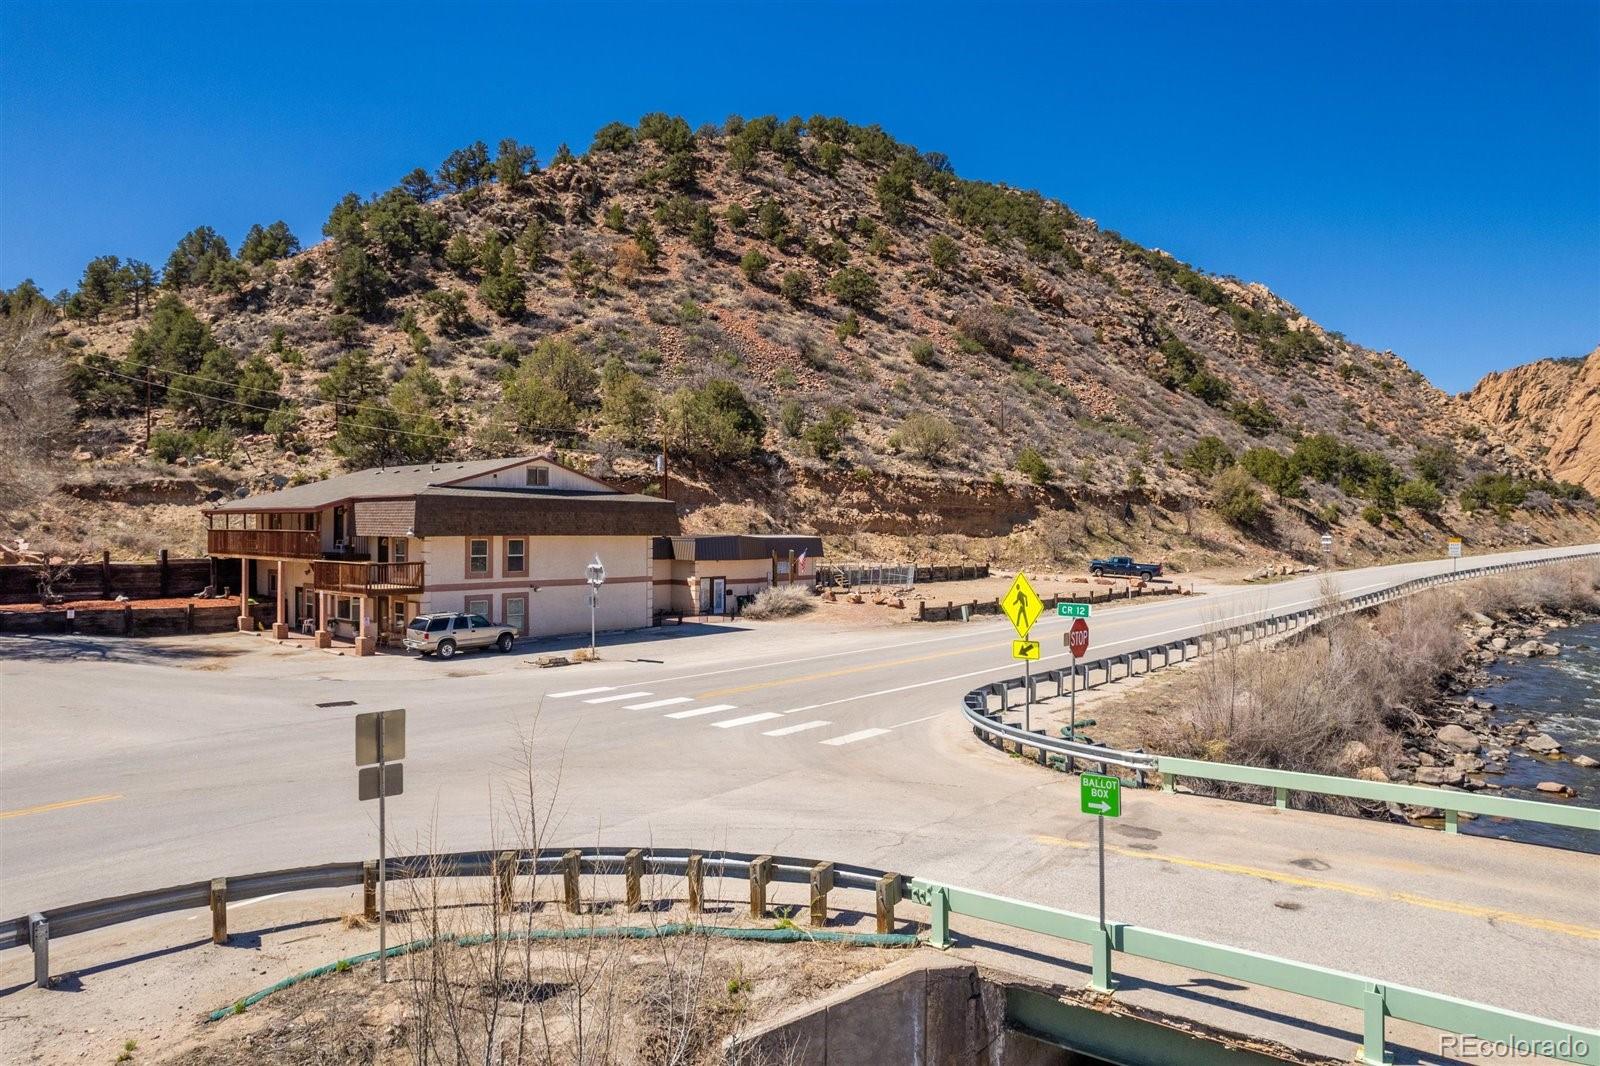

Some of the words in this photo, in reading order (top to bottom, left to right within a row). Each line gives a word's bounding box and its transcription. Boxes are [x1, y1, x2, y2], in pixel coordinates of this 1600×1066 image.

[1062, 606, 1072, 614] CR
[1076, 606, 1086, 616] 12
[1070, 630, 1088, 646] STOP
[1082, 778, 1117, 790] BALLOT
[1091, 788, 1108, 799] BOX
